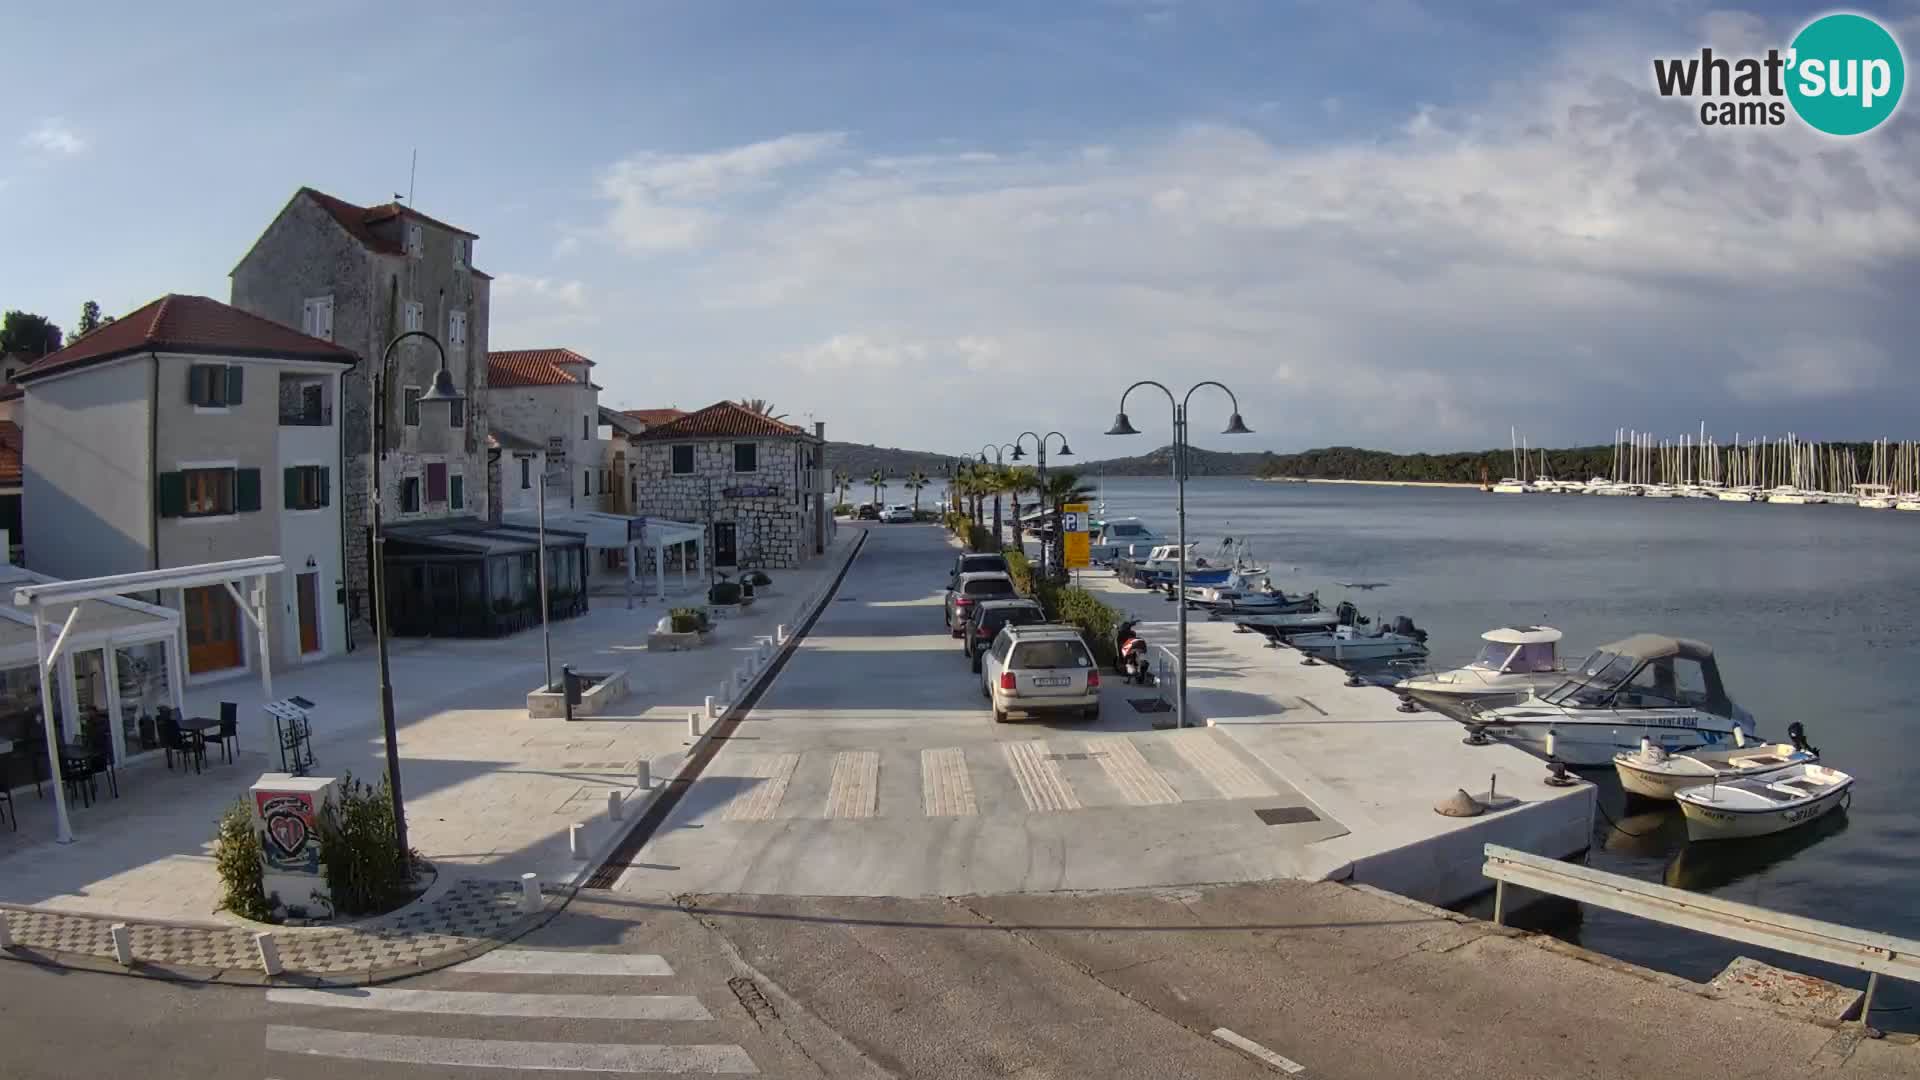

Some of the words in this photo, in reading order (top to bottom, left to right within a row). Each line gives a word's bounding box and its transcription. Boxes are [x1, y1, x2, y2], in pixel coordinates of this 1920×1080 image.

[1066, 514, 1076, 530] P
[1658, 717, 1675, 726] RENT
[1682, 717, 1698, 728] BOAT
